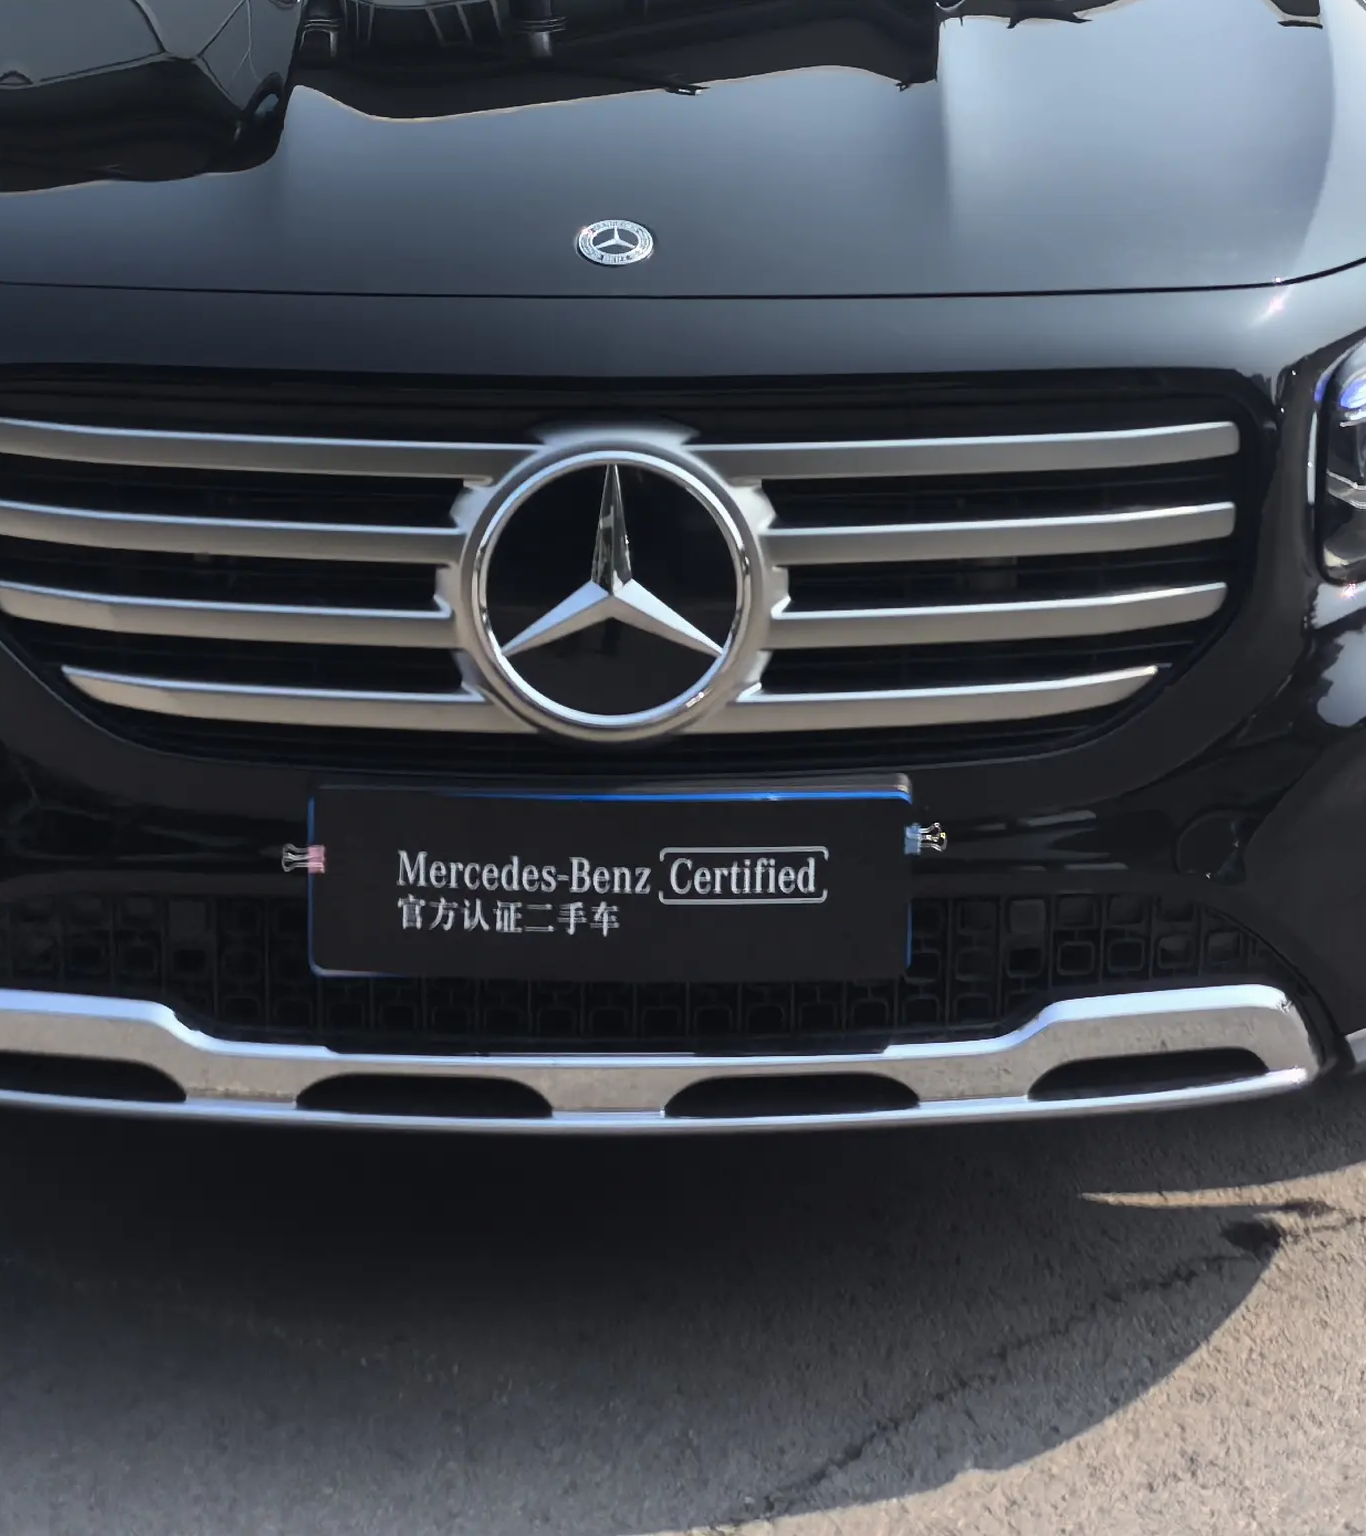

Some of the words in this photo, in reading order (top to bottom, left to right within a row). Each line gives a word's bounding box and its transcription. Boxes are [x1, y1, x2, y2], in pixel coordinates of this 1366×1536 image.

[397, 849, 652, 895] Mercedes-Benz
[669, 857, 816, 895] Certified
[397, 894, 620, 937] 官方认证二手车
